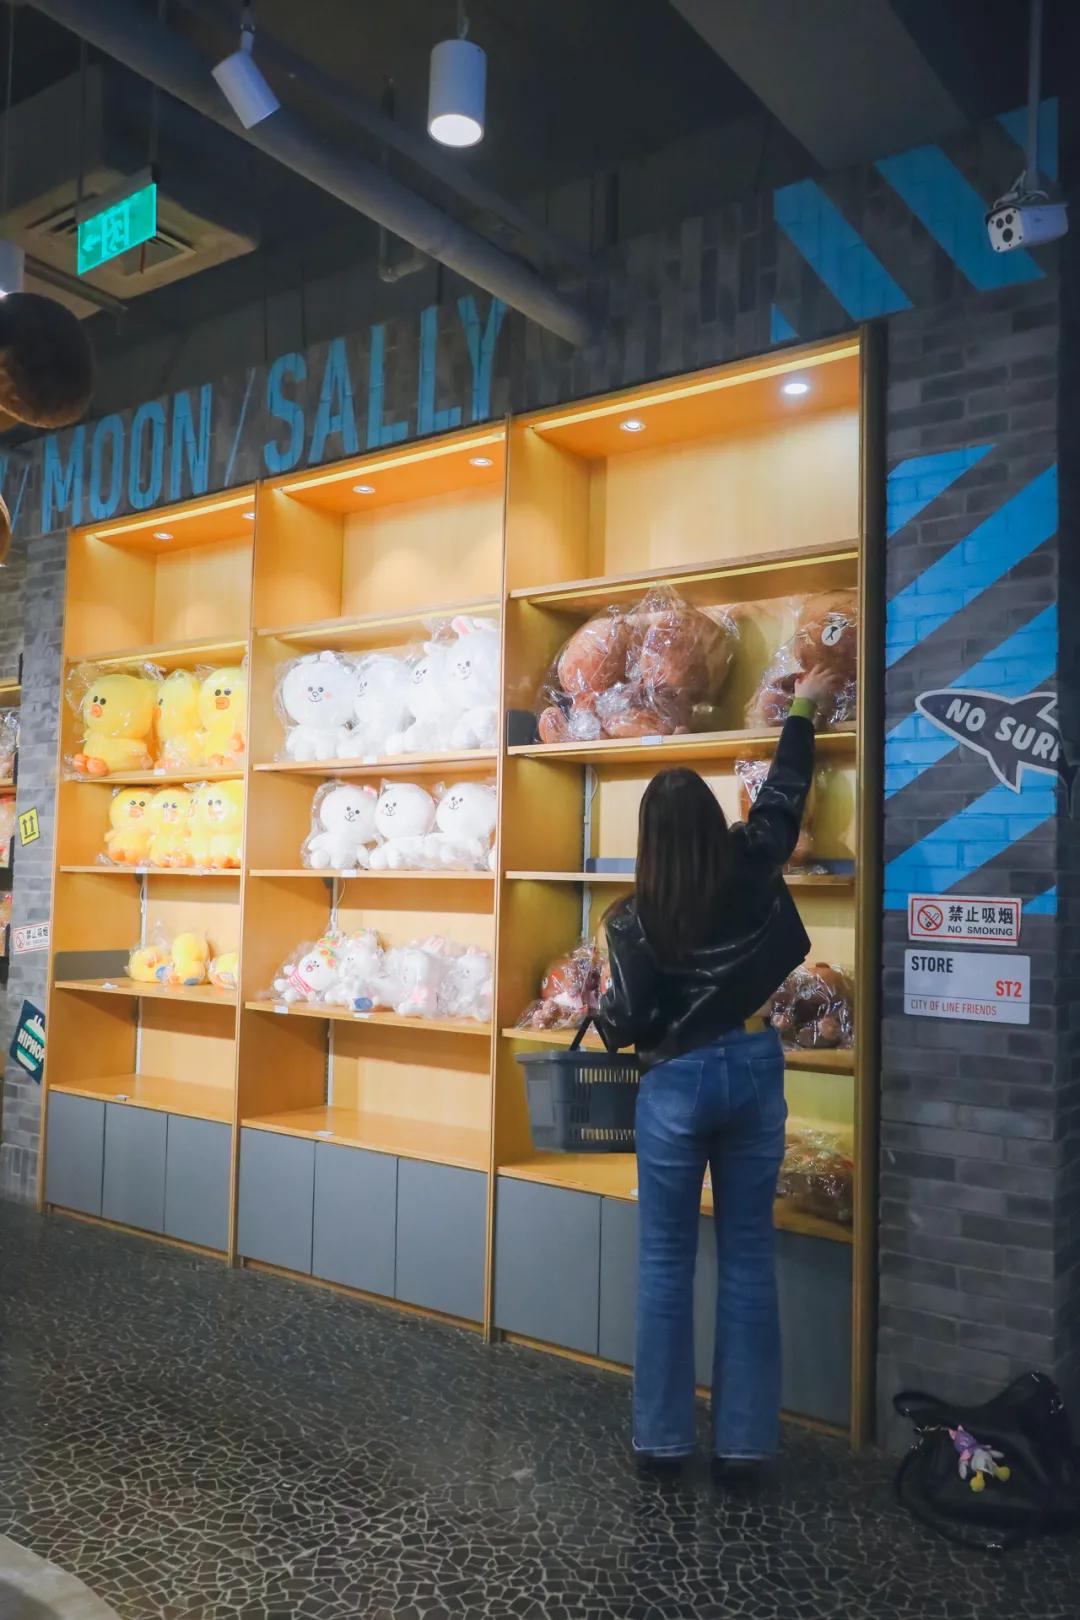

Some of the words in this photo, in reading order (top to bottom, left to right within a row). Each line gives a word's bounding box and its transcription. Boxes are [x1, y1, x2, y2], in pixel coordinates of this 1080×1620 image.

[41, 382, 213, 535] MOON
[263, 295, 508, 474] SALLY
[945, 698, 986, 732] NO
[948, 905, 1014, 925] 禁止吸烟
[947, 925, 962, 934] NO
[967, 926, 1013, 936] SMOKING
[911, 955, 954, 973] STORE
[995, 980, 1022, 998] ST2
[911, 999, 928, 1010] CITY
[929, 1001, 940, 1011] OF
[942, 1002, 960, 1013] LINE
[962, 1003, 997, 1016] FRIENDS
